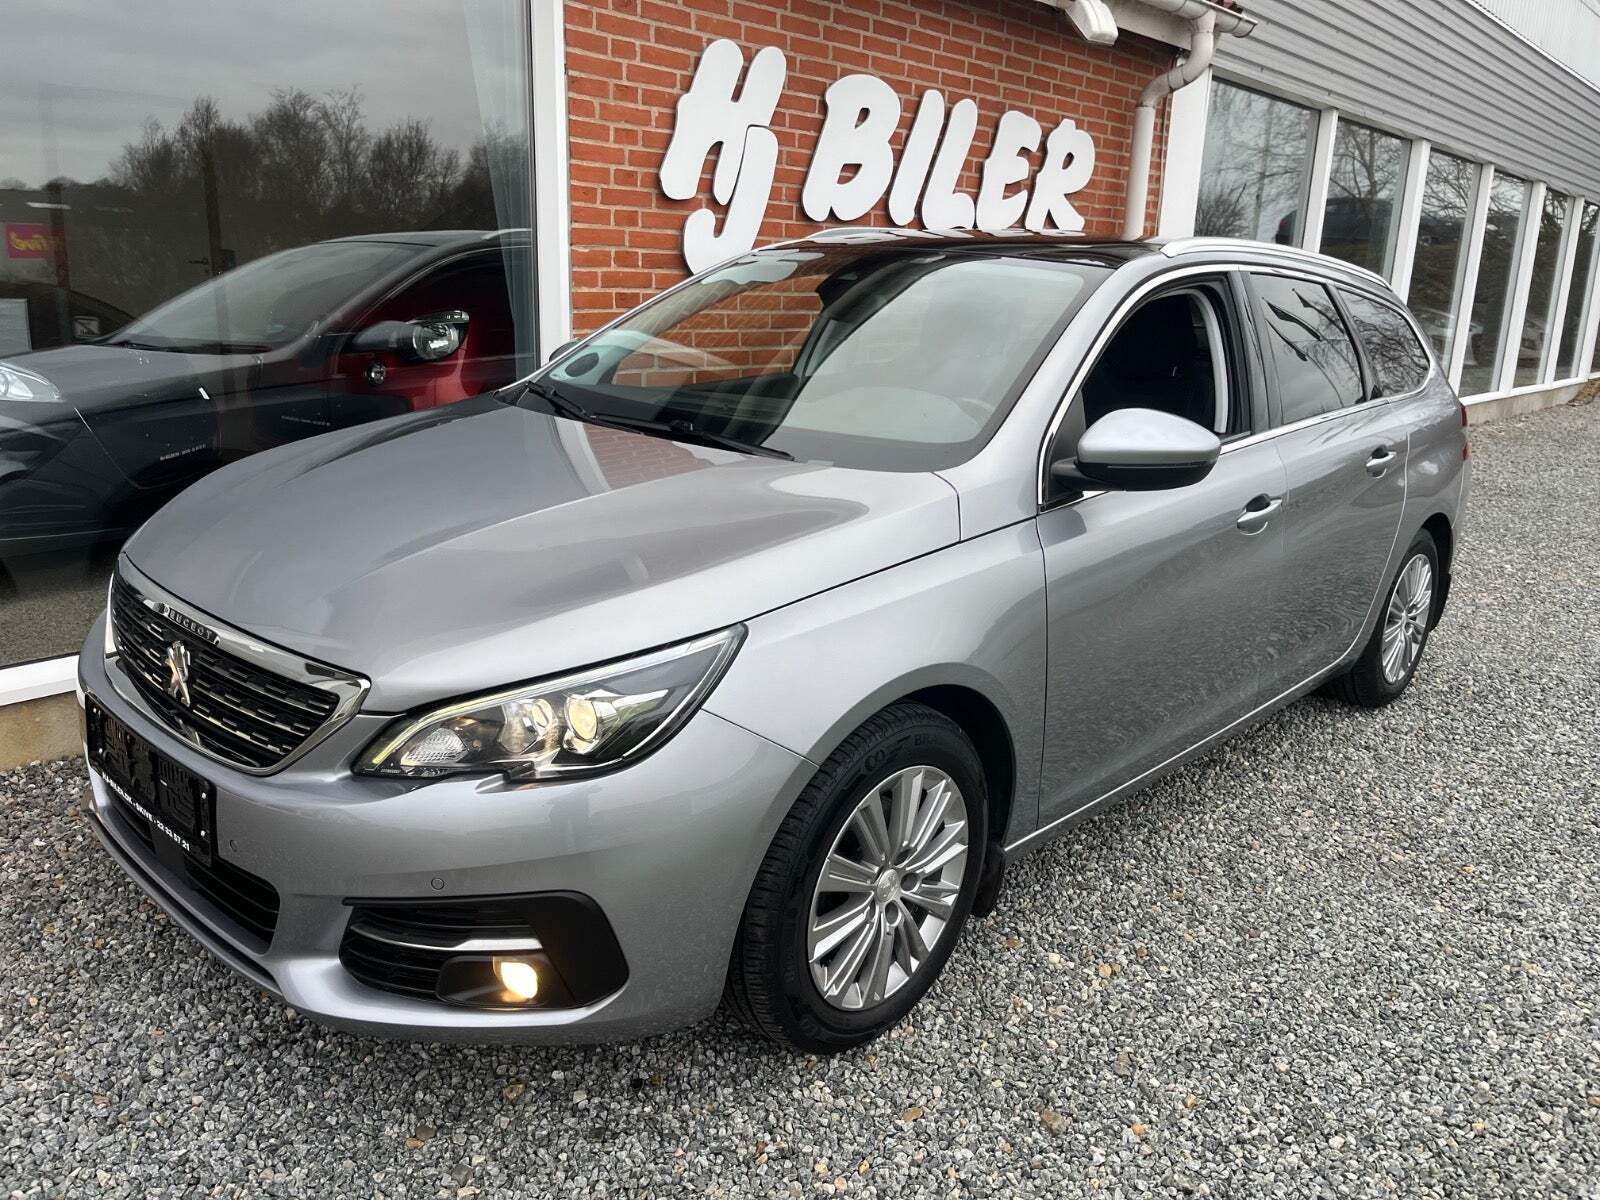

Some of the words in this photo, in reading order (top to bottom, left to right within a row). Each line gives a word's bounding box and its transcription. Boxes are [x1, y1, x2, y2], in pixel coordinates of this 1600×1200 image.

[659, 38, 787, 276] HJ
[802, 74, 1096, 232] BILER
[163, 603, 213, 640] PEUGEOT
